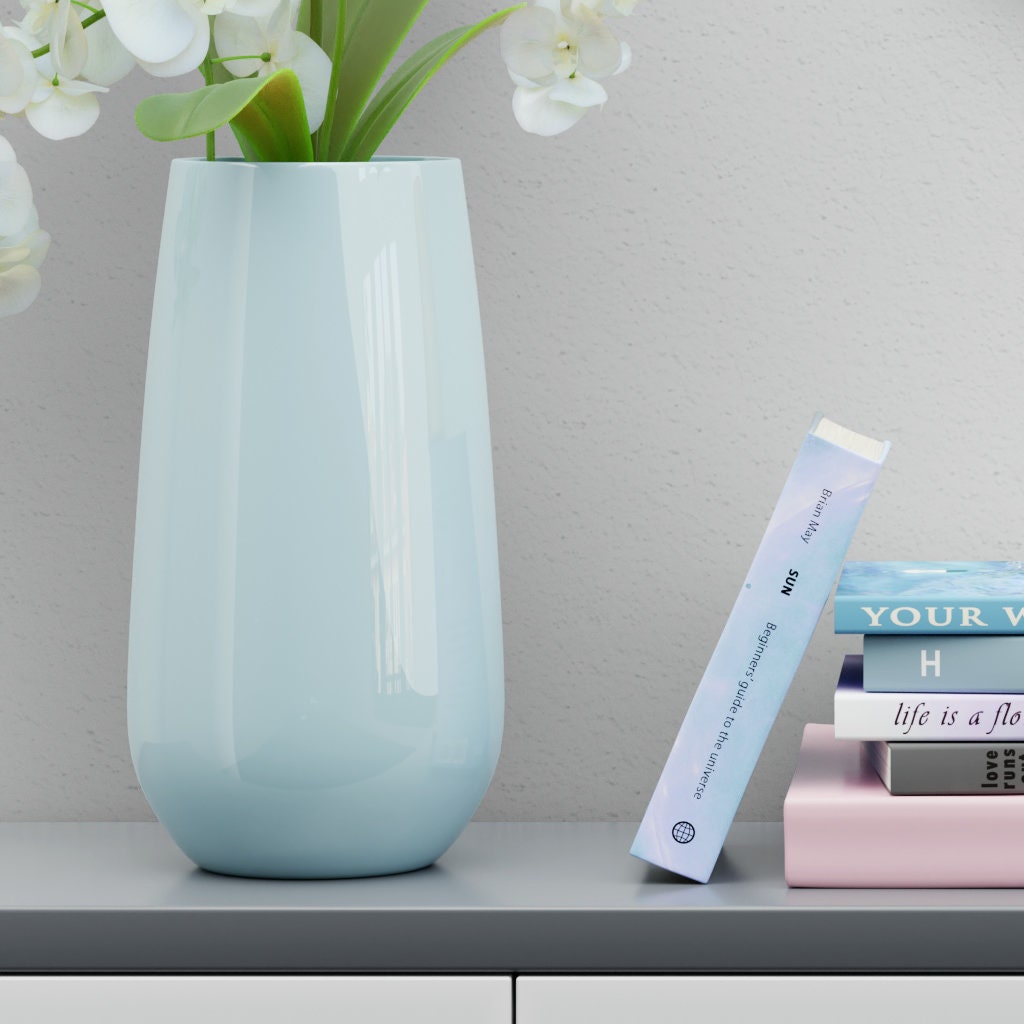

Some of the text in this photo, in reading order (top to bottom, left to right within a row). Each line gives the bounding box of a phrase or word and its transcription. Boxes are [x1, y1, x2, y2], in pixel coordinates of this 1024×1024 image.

[800, 488, 833, 544] Brian May
[781, 568, 799, 596] SUN
[861, 607, 988, 627] YOUR
[730, 681, 749, 714] guide
[723, 716, 735, 728] to
[894, 702, 930, 735] life
[940, 705, 958, 726] is
[968, 711, 983, 726] a
[714, 731, 729, 750] the
[694, 752, 719, 800] universe
[981, 750, 999, 789] love
[1003, 748, 1016, 790] runs
